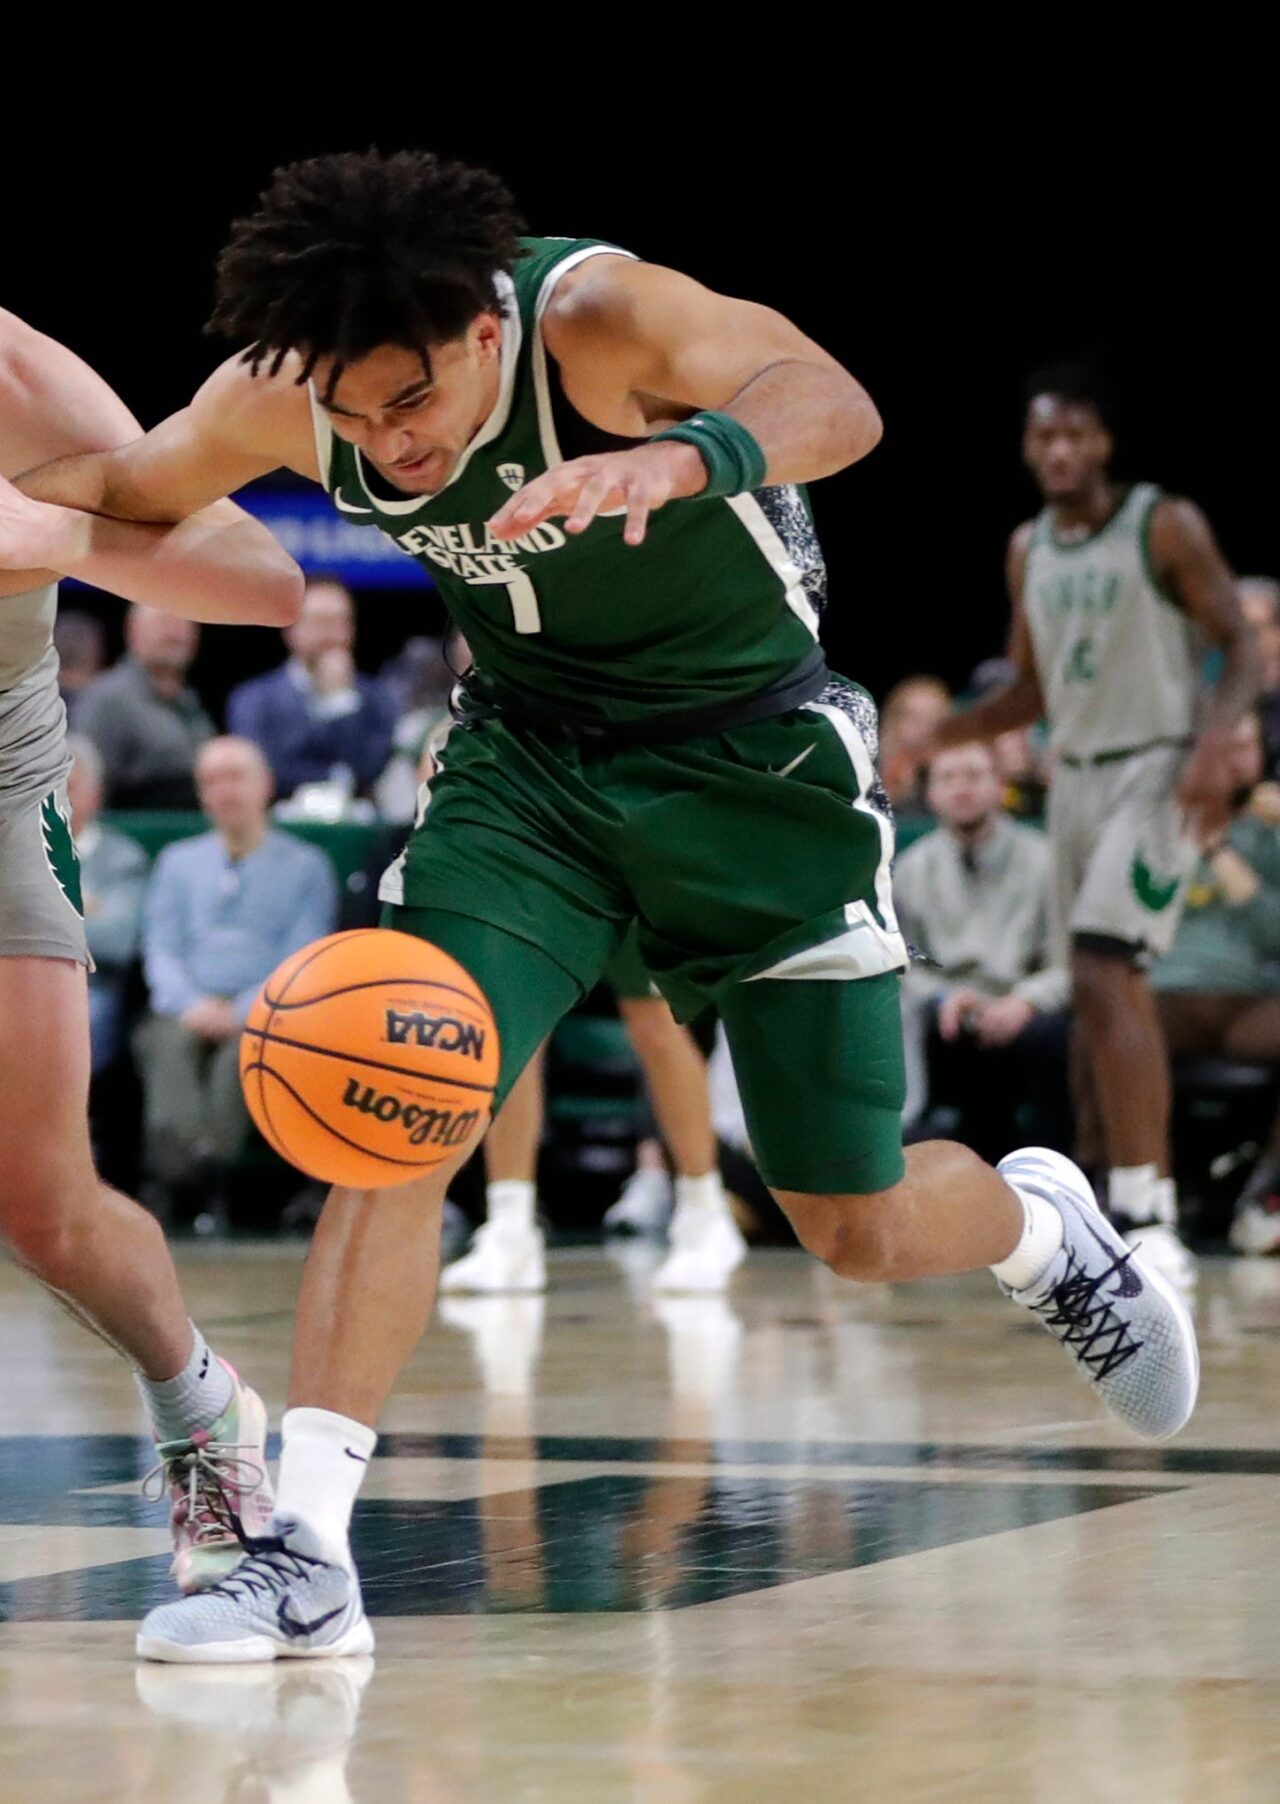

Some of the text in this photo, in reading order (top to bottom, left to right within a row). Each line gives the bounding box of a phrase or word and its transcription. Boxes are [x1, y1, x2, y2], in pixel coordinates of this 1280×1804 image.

[423, 545, 519, 579] STATE
[385, 1008, 485, 1063] NCAA
[342, 1076, 480, 1146] Wilson
